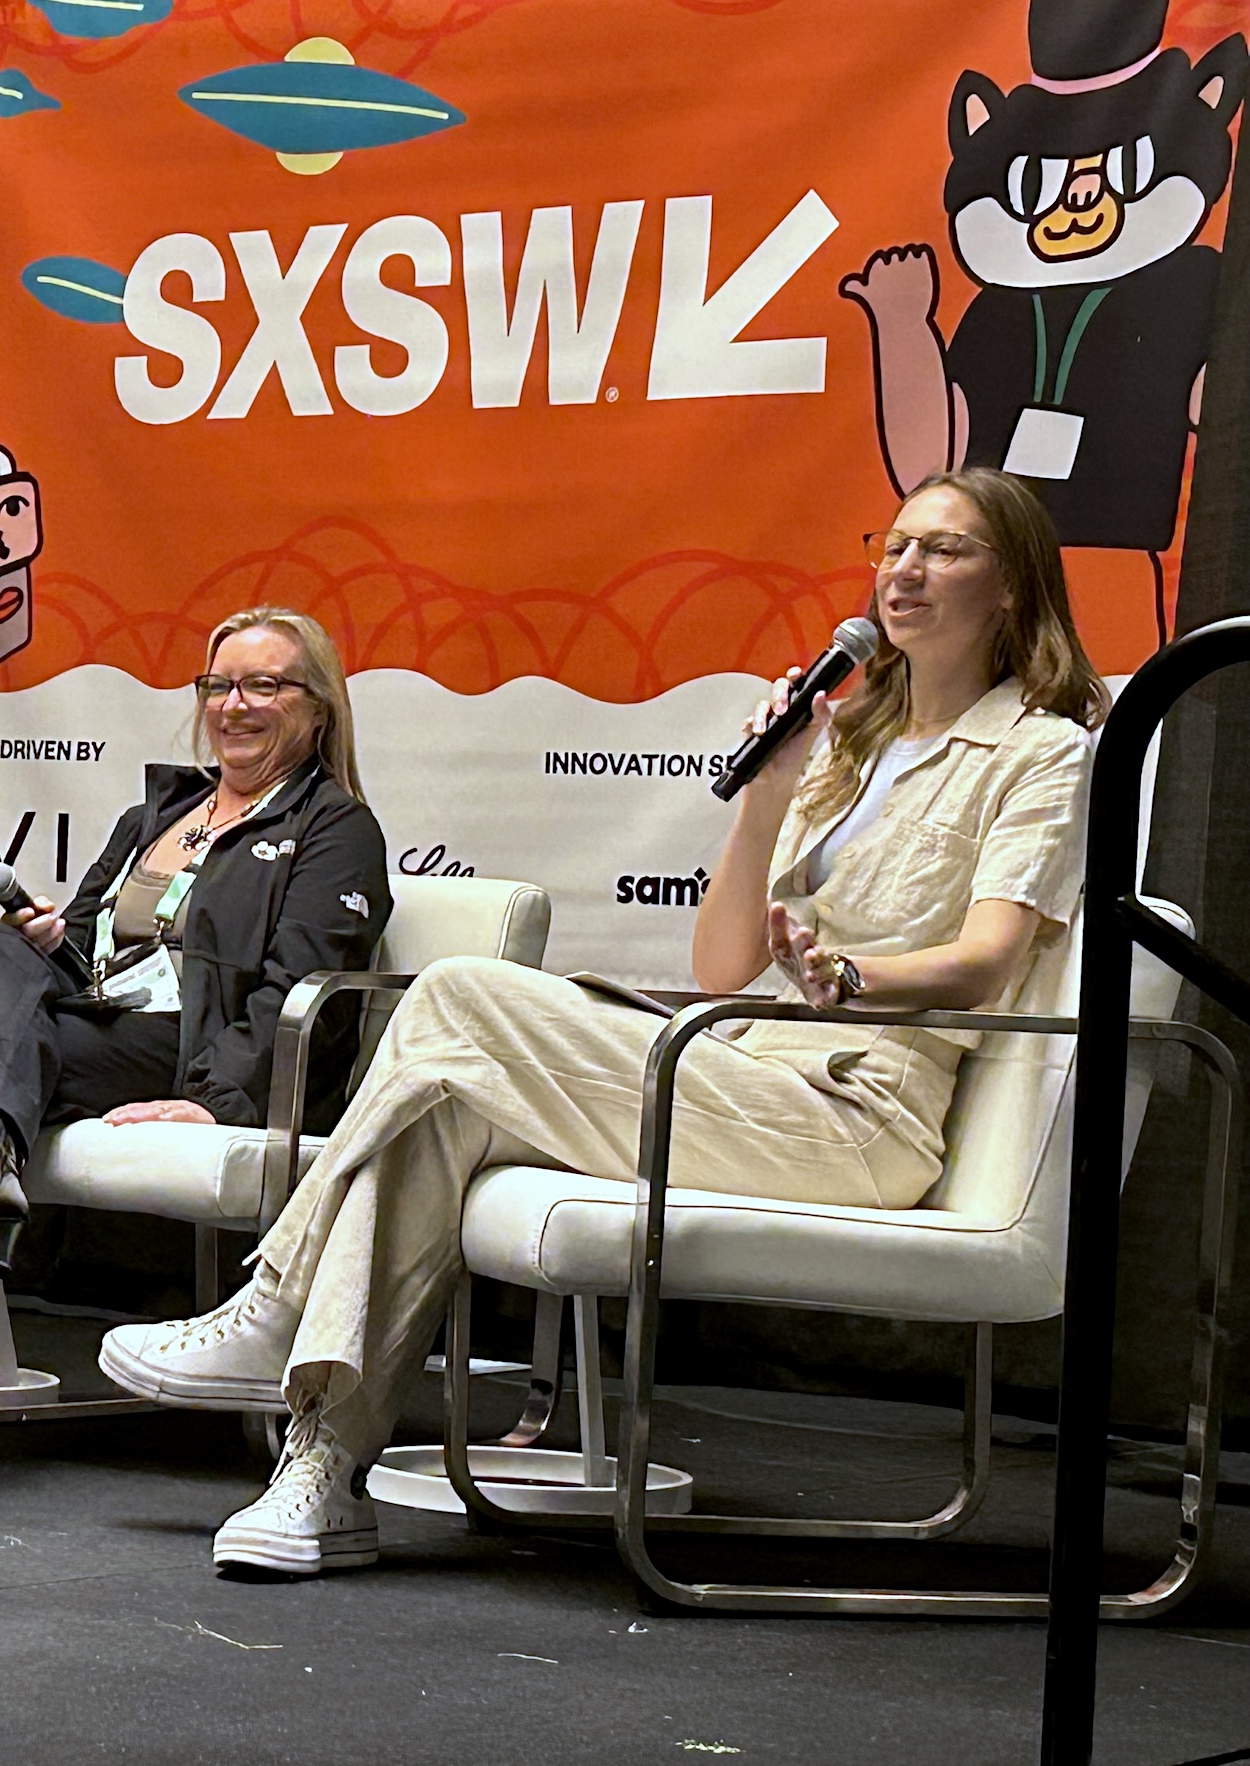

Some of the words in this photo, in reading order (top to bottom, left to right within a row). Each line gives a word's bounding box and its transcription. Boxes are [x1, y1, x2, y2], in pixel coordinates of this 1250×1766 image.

[114, 199, 645, 425] SXSW
[0, 739, 72, 761] DRIVEN
[76, 741, 106, 762] BY
[545, 751, 704, 777] INNOVATION
